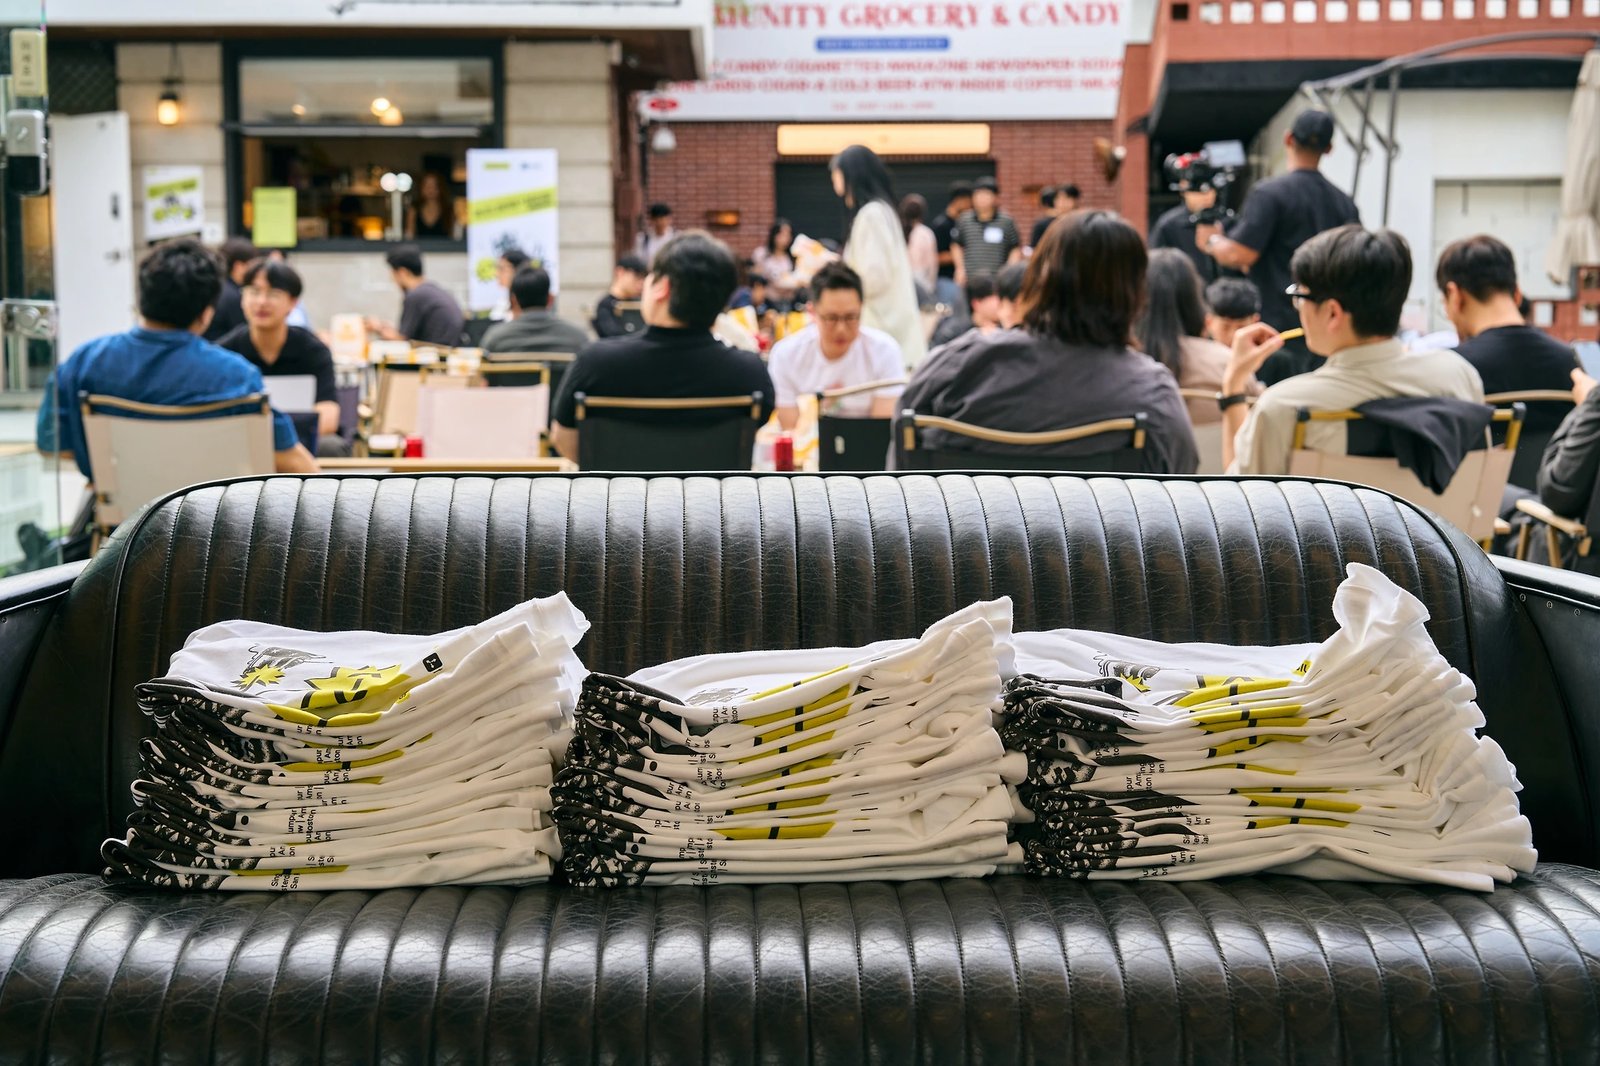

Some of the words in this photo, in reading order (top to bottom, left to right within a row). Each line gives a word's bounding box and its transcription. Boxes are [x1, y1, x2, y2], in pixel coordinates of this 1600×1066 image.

[839, 1, 978, 28] GROCERY
[990, 3, 1011, 27] &
[1018, 1, 1121, 27] CANDY
